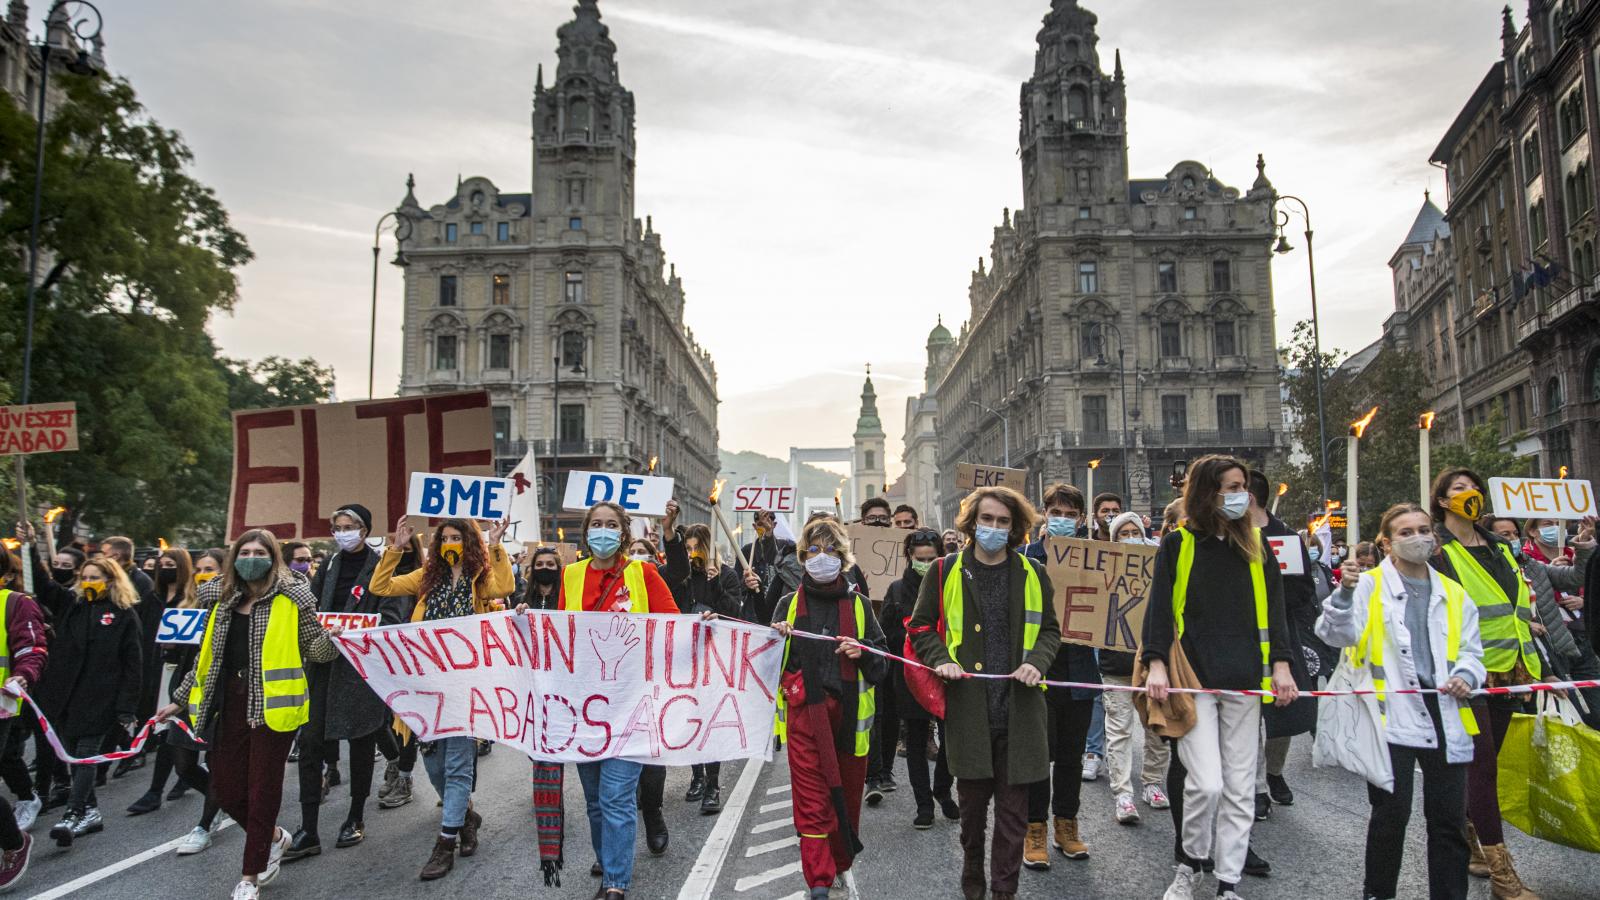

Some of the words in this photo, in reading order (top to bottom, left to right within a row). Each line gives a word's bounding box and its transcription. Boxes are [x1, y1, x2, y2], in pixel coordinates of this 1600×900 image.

[230, 391, 492, 541] ELTE
[420, 477, 505, 519] BME
[585, 474, 643, 509] DE
[735, 487, 792, 510] SZTE
[1502, 482, 1590, 513] METU
[1054, 545, 1153, 579] VELETEK
[1104, 573, 1150, 597] VAGY
[386, 685, 747, 758] SZABADSÁGA
